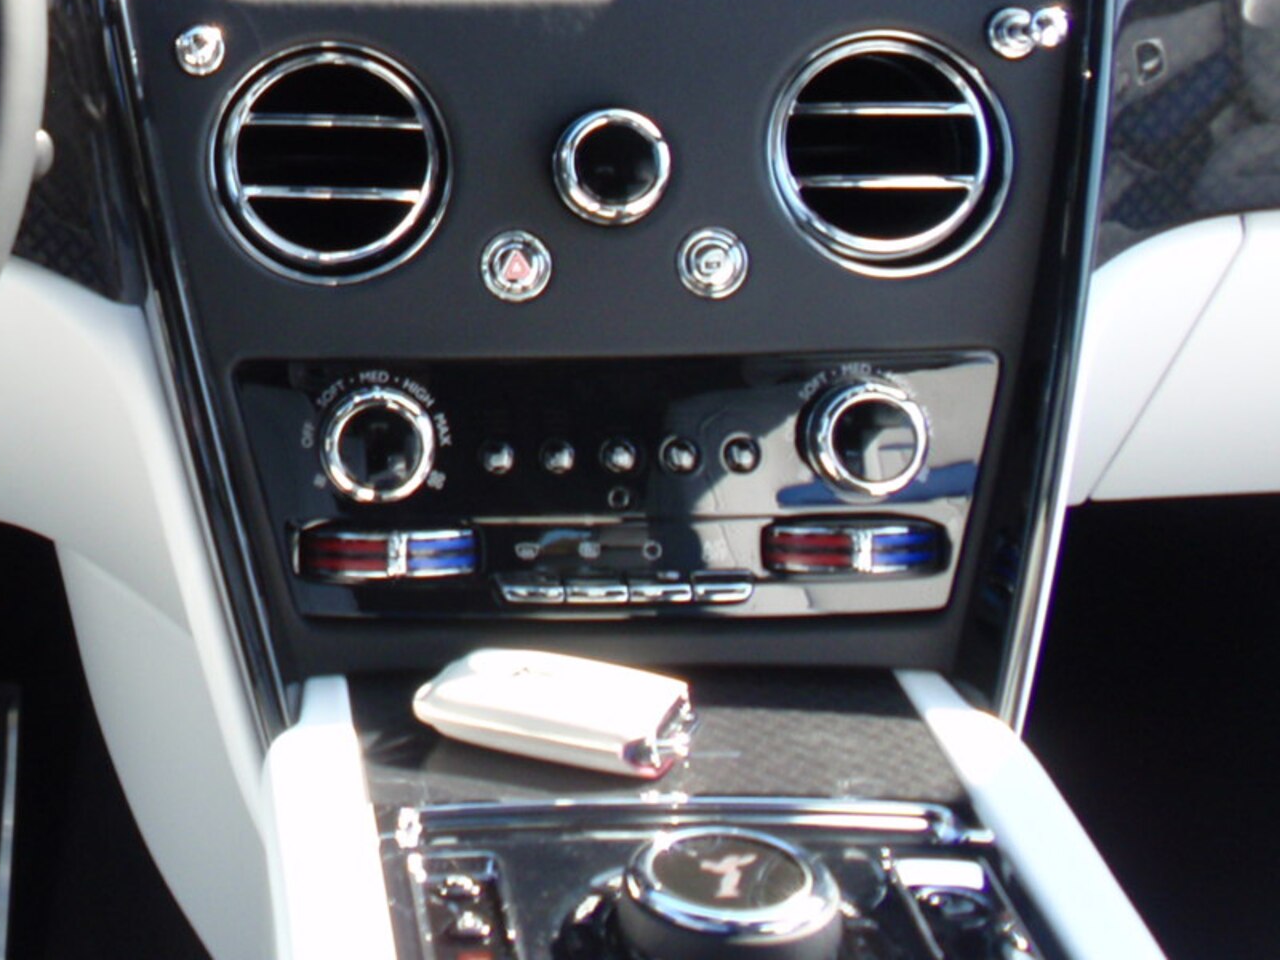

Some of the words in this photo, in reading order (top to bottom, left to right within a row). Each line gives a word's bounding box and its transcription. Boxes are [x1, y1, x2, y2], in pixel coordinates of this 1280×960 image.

[301, 422, 314, 449] OFF
[317, 380, 345, 407] SOFT
[359, 370, 389, 383] MED
[402, 378, 435, 408] HIGH
[433, 413, 451, 446] MAX
